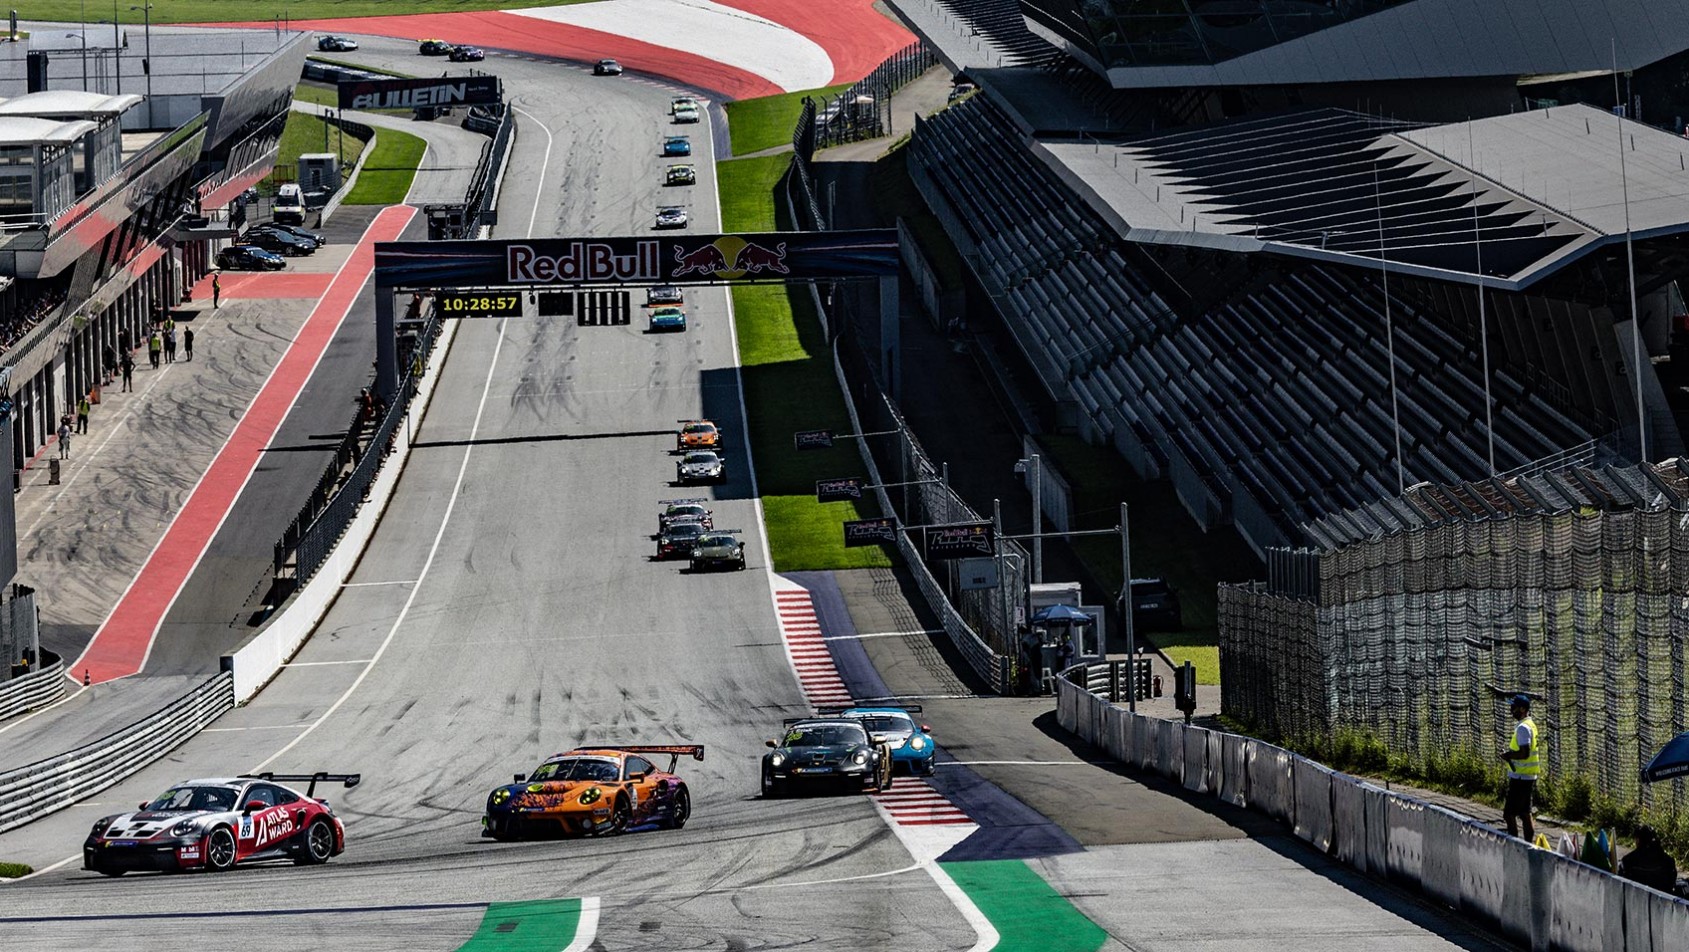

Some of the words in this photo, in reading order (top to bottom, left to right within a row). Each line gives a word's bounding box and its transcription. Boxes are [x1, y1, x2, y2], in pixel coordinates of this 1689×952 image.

[443, 297, 518, 312] 10:28:57
[266, 808, 290, 827] ATLAS
[241, 825, 251, 837] 69
[268, 820, 293, 841] WARD
